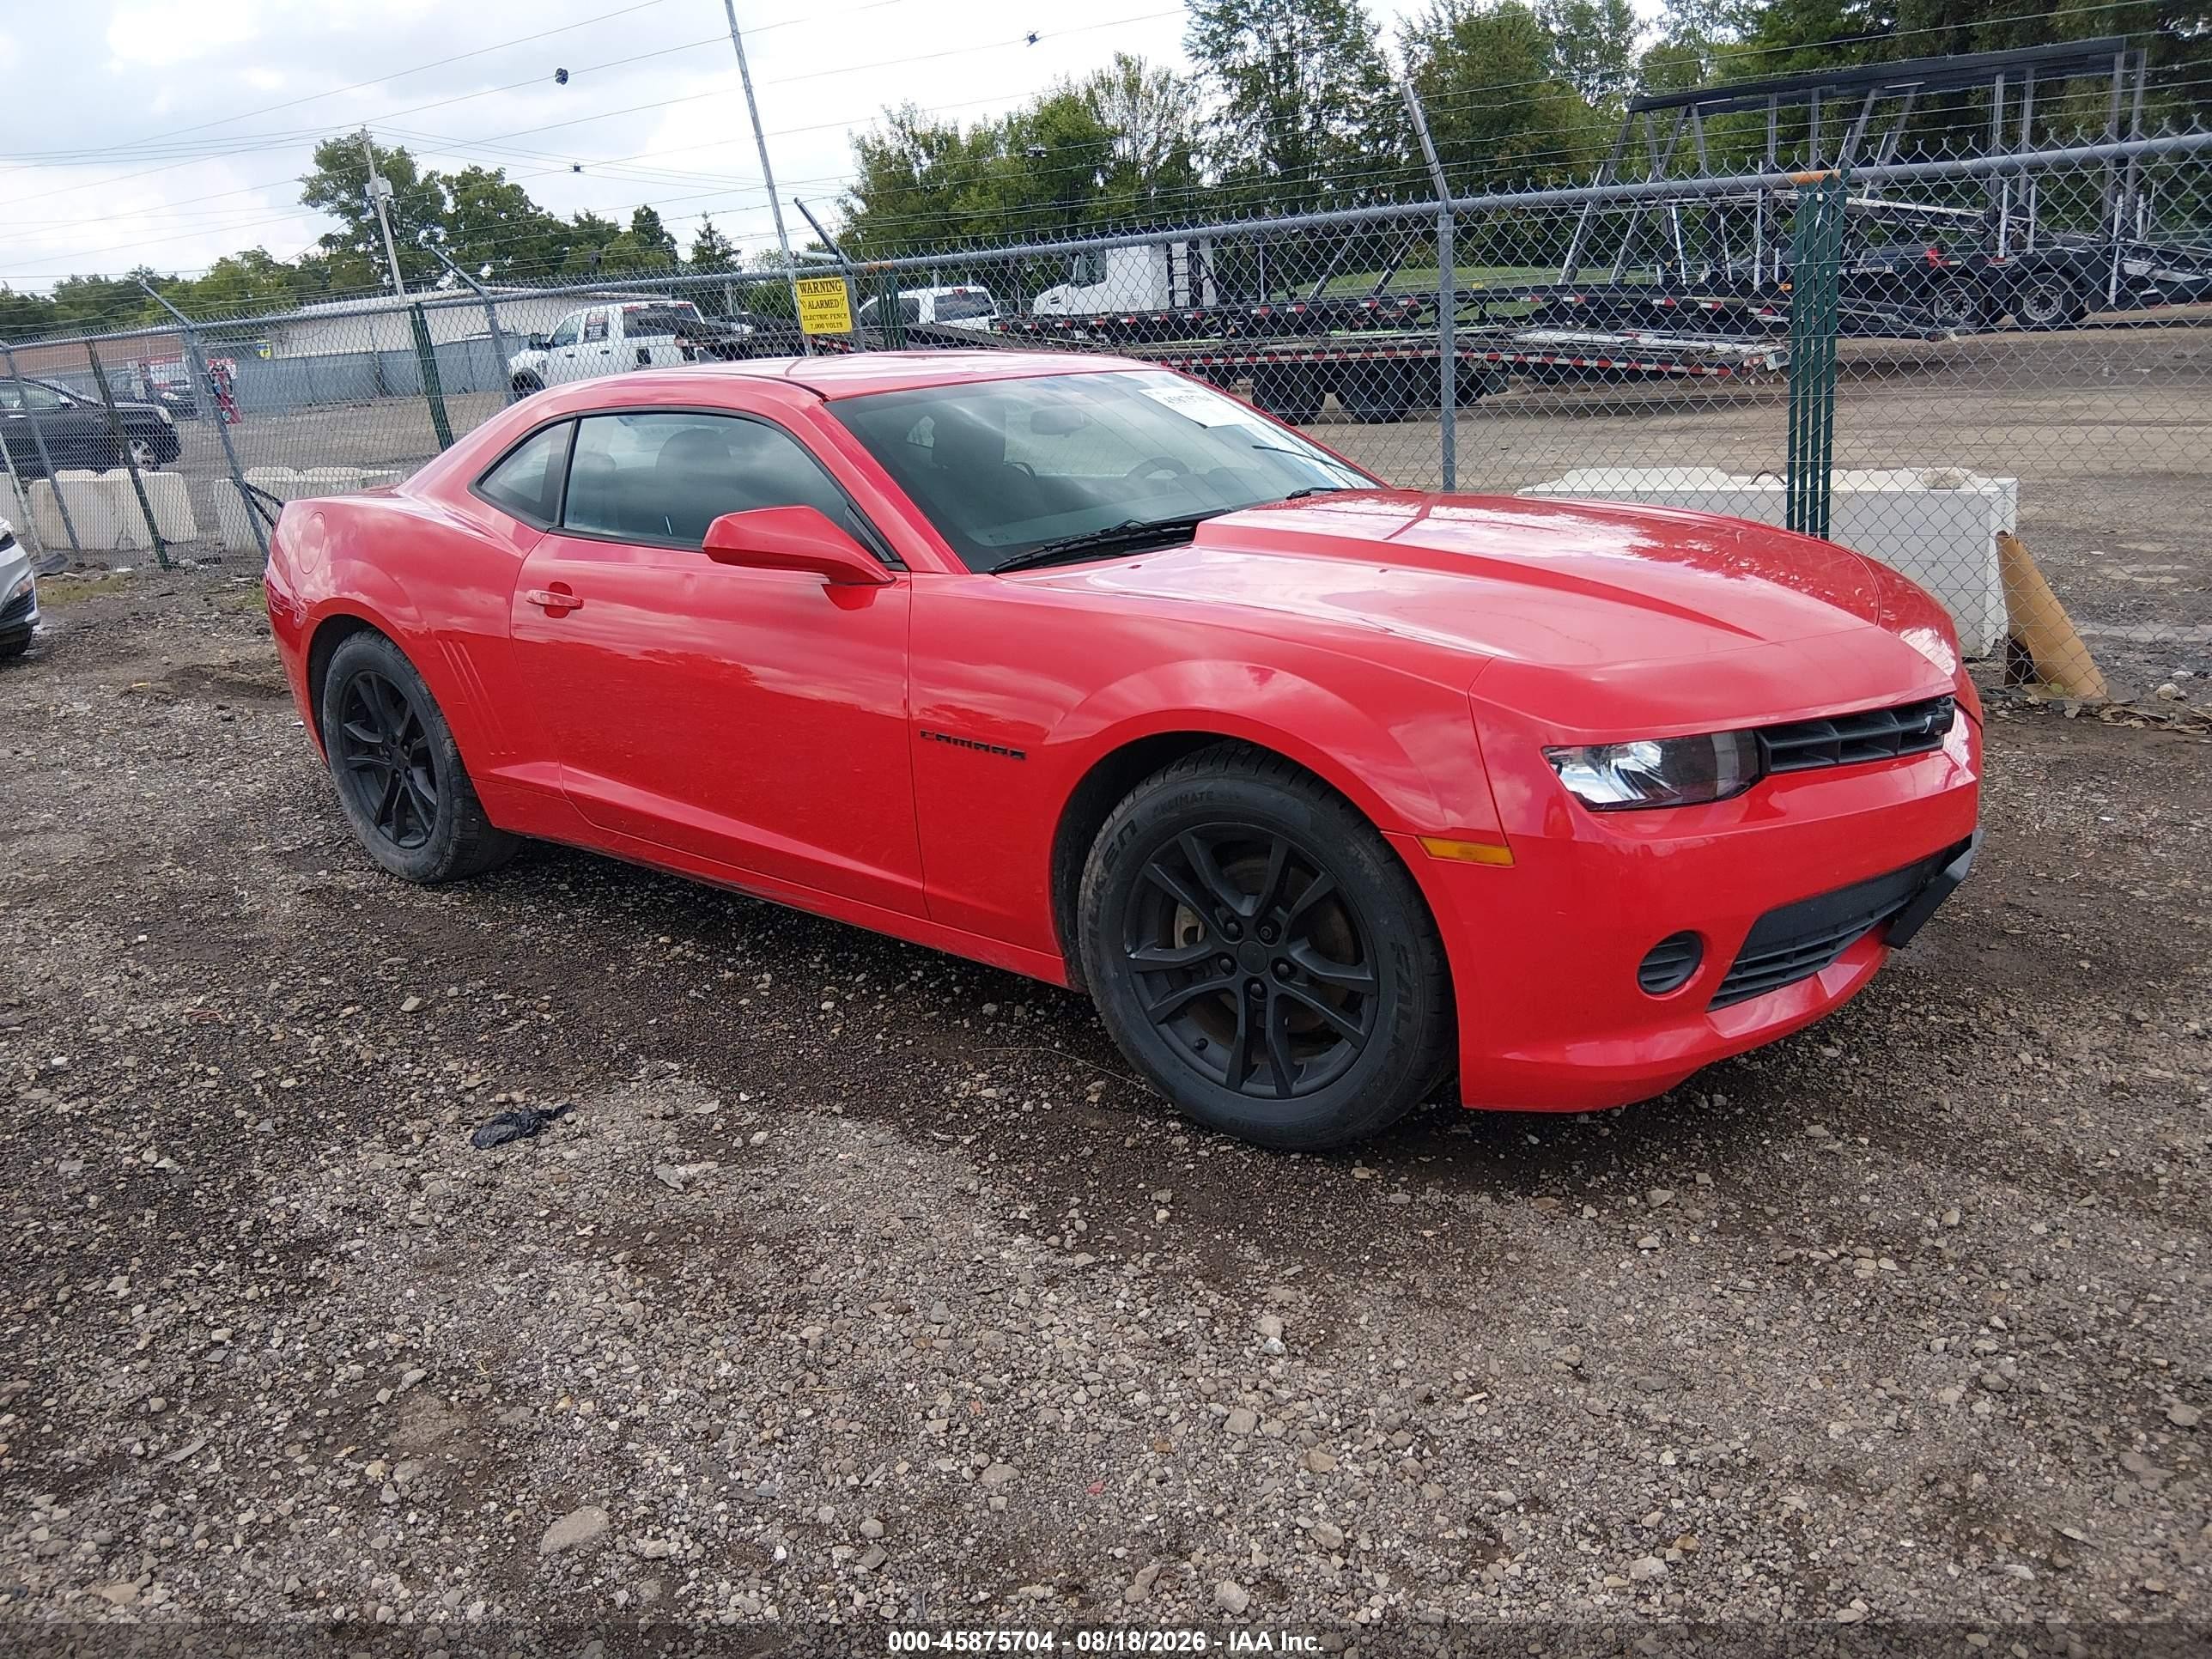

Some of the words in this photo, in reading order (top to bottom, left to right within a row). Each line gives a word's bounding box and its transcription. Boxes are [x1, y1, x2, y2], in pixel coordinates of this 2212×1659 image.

[799, 280, 842, 294] WARNING
[807, 300, 840, 309] ALARMED
[920, 729, 1026, 761] CAMARO
